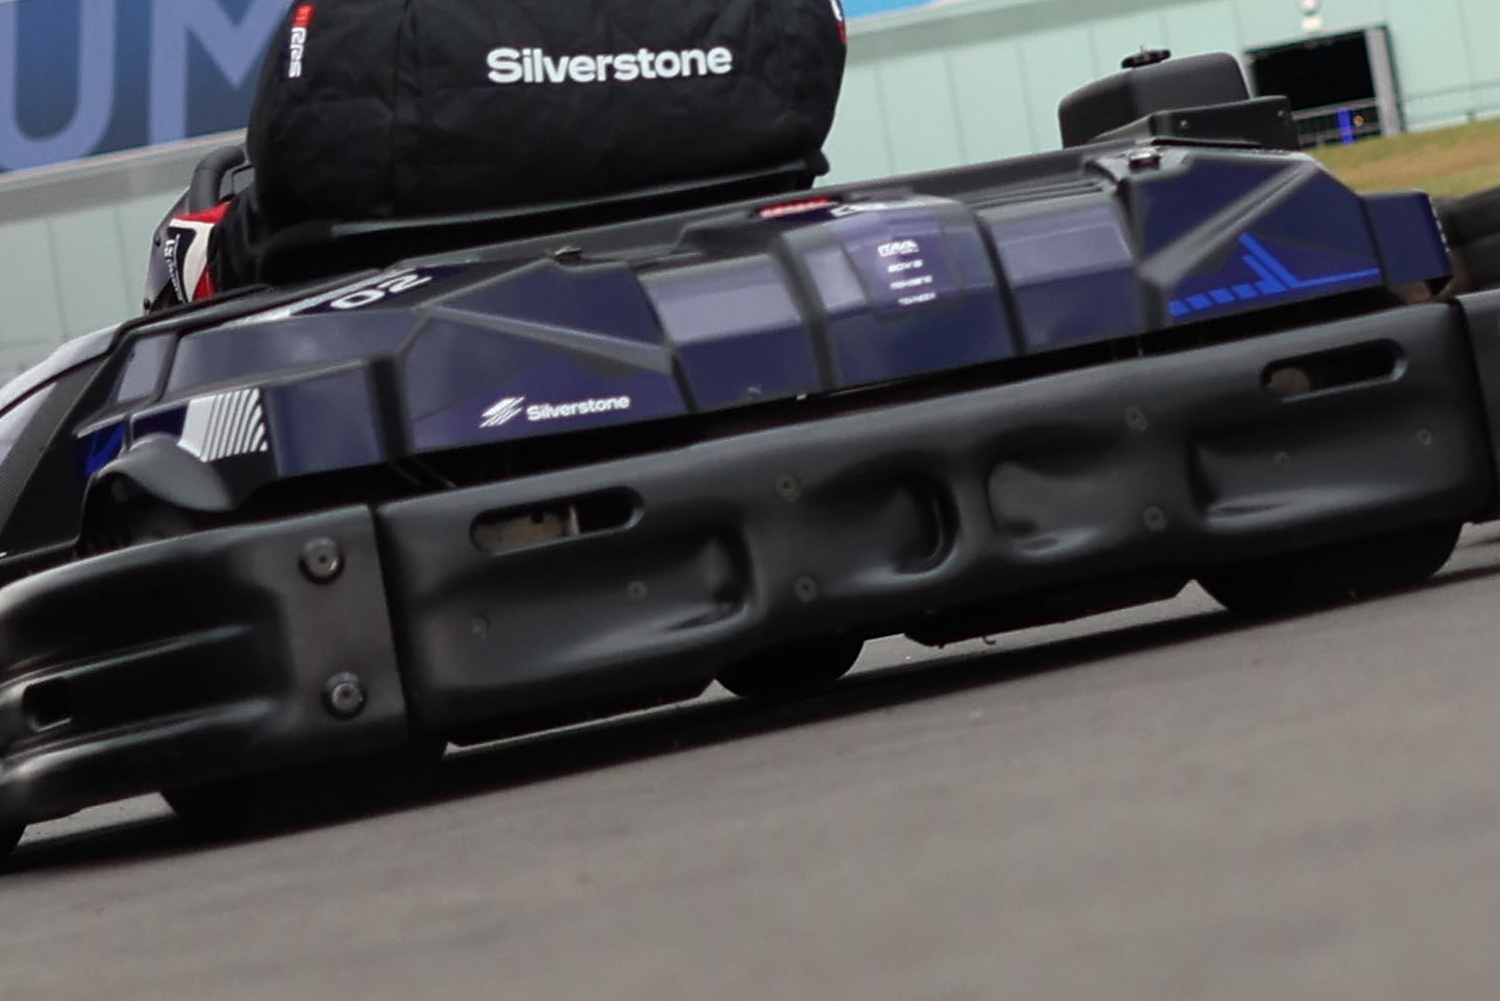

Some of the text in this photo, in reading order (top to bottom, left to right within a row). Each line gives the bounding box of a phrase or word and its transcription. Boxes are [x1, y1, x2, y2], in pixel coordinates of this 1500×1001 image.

[288, 26, 307, 78] RRS
[486, 46, 733, 83] Silverstone
[329, 273, 433, 309] 02
[525, 396, 631, 422] Silverstone
